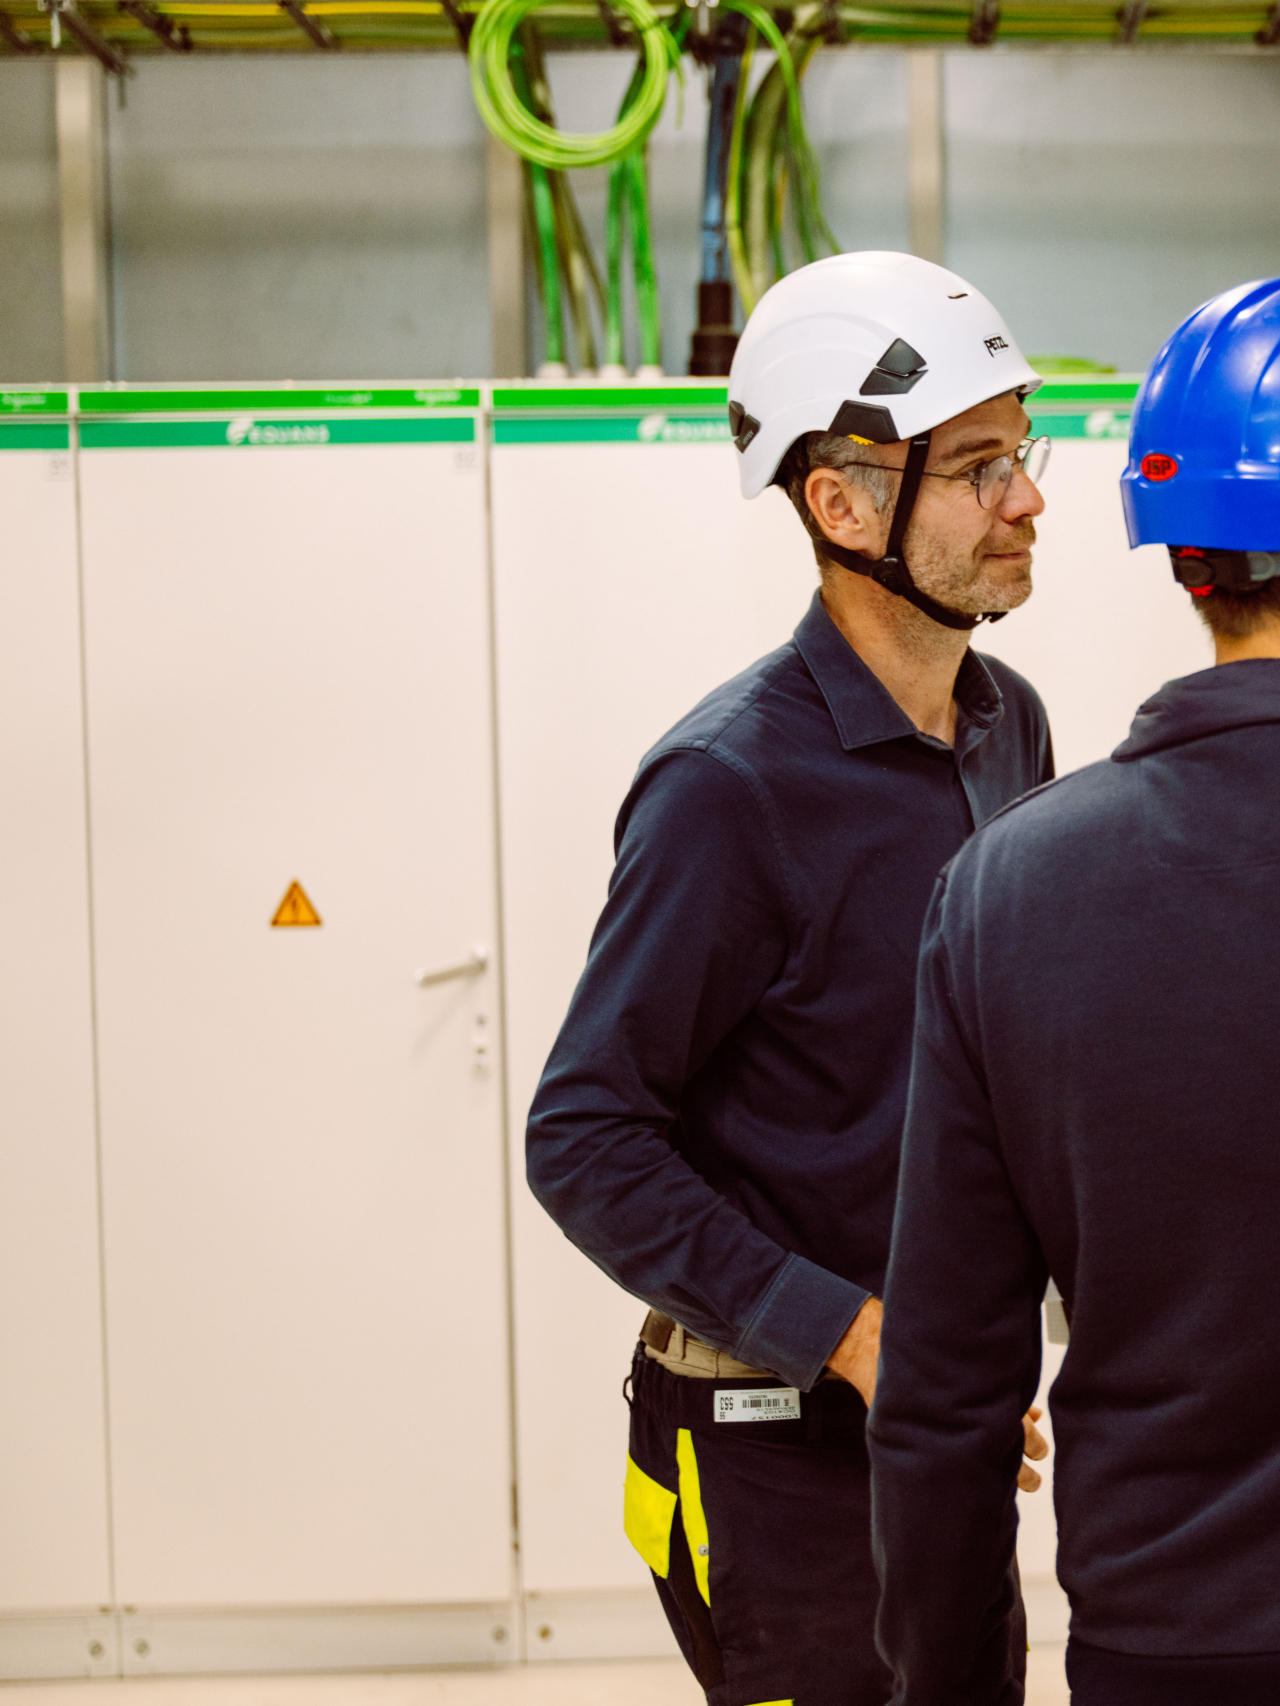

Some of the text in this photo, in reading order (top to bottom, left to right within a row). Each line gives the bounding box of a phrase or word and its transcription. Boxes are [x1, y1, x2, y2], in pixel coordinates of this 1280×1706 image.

[983, 336, 1009, 358] PETZL
[1145, 459, 1171, 475] JSP
[720, 1397, 734, 1411] 553
